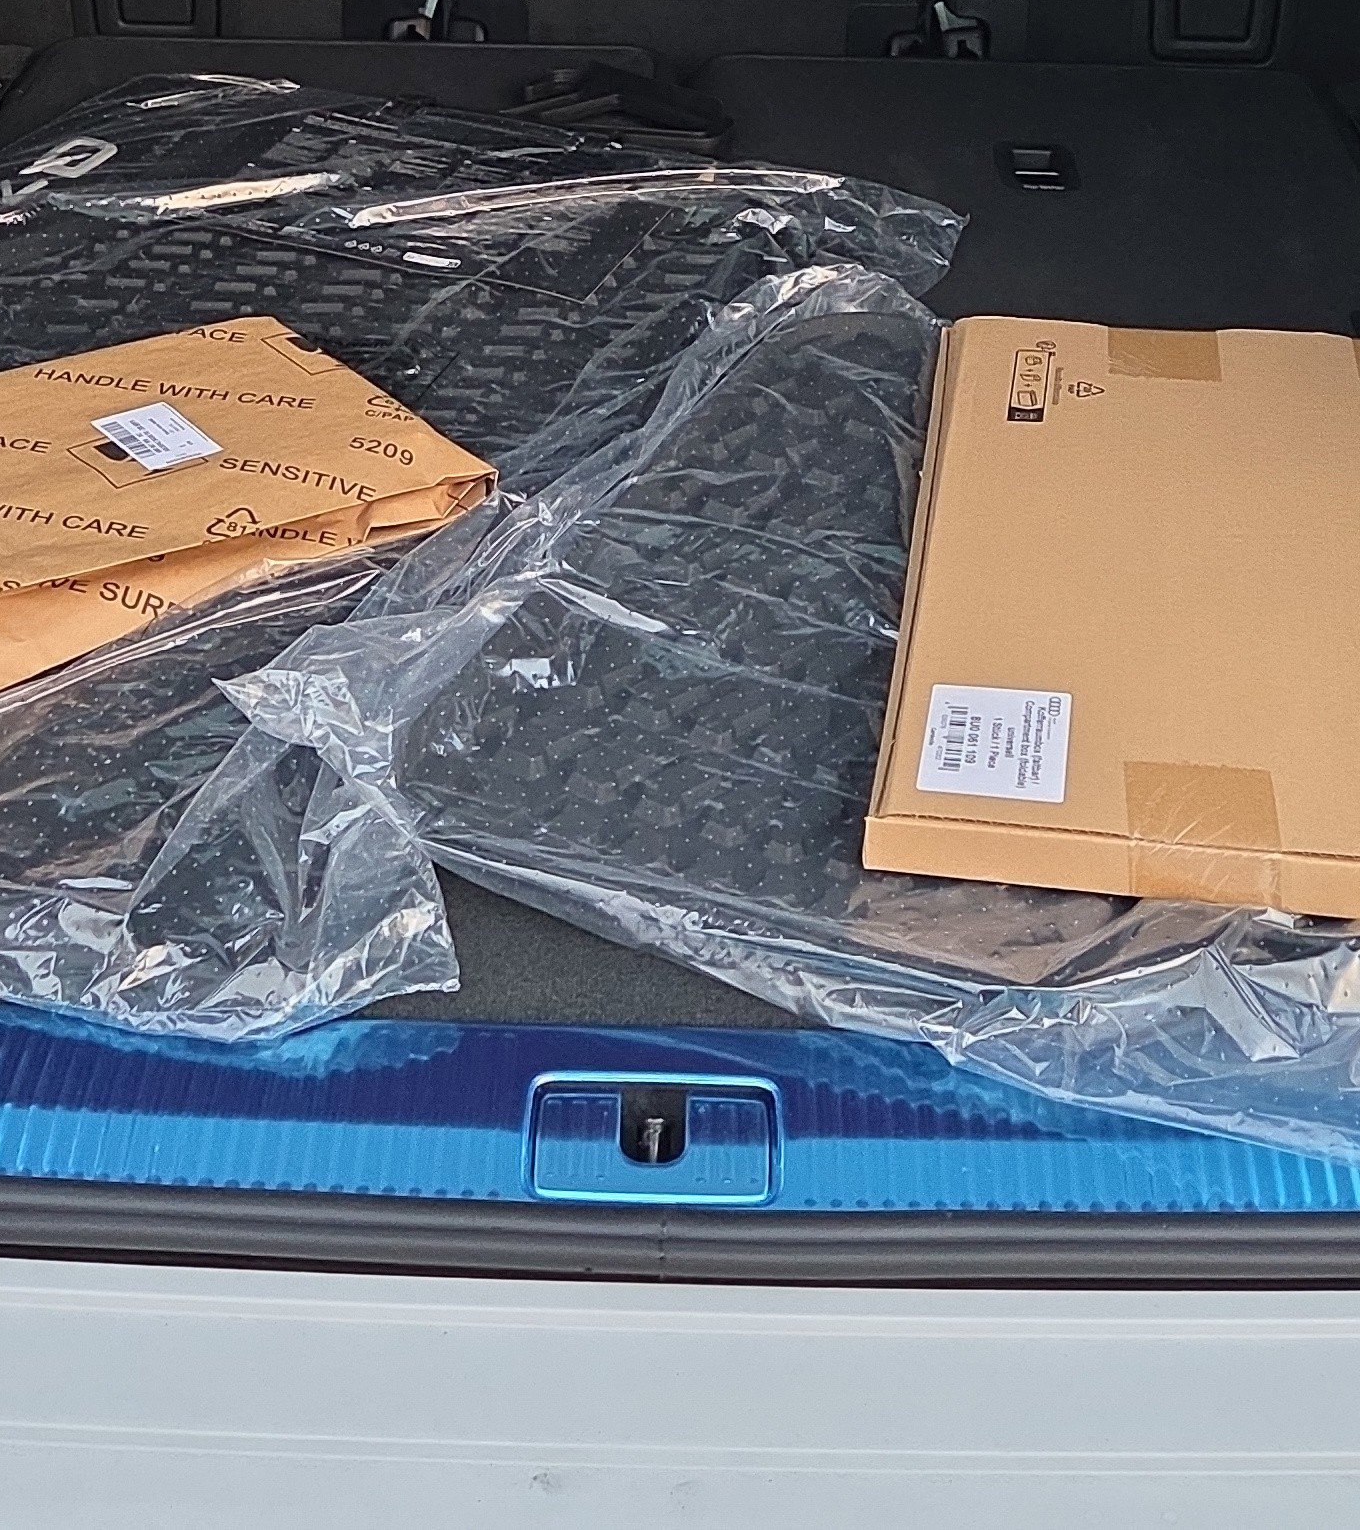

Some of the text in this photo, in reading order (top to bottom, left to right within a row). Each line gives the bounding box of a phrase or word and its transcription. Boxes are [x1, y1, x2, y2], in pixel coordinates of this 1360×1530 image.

[175, 326, 247, 344] ACE
[33, 368, 317, 410] HANDLE WITH CARE
[348, 436, 415, 467] 5209
[218, 457, 377, 503] SENSITIVE
[61, 515, 150, 540] CARE
[1019, 744, 1030, 756] box
